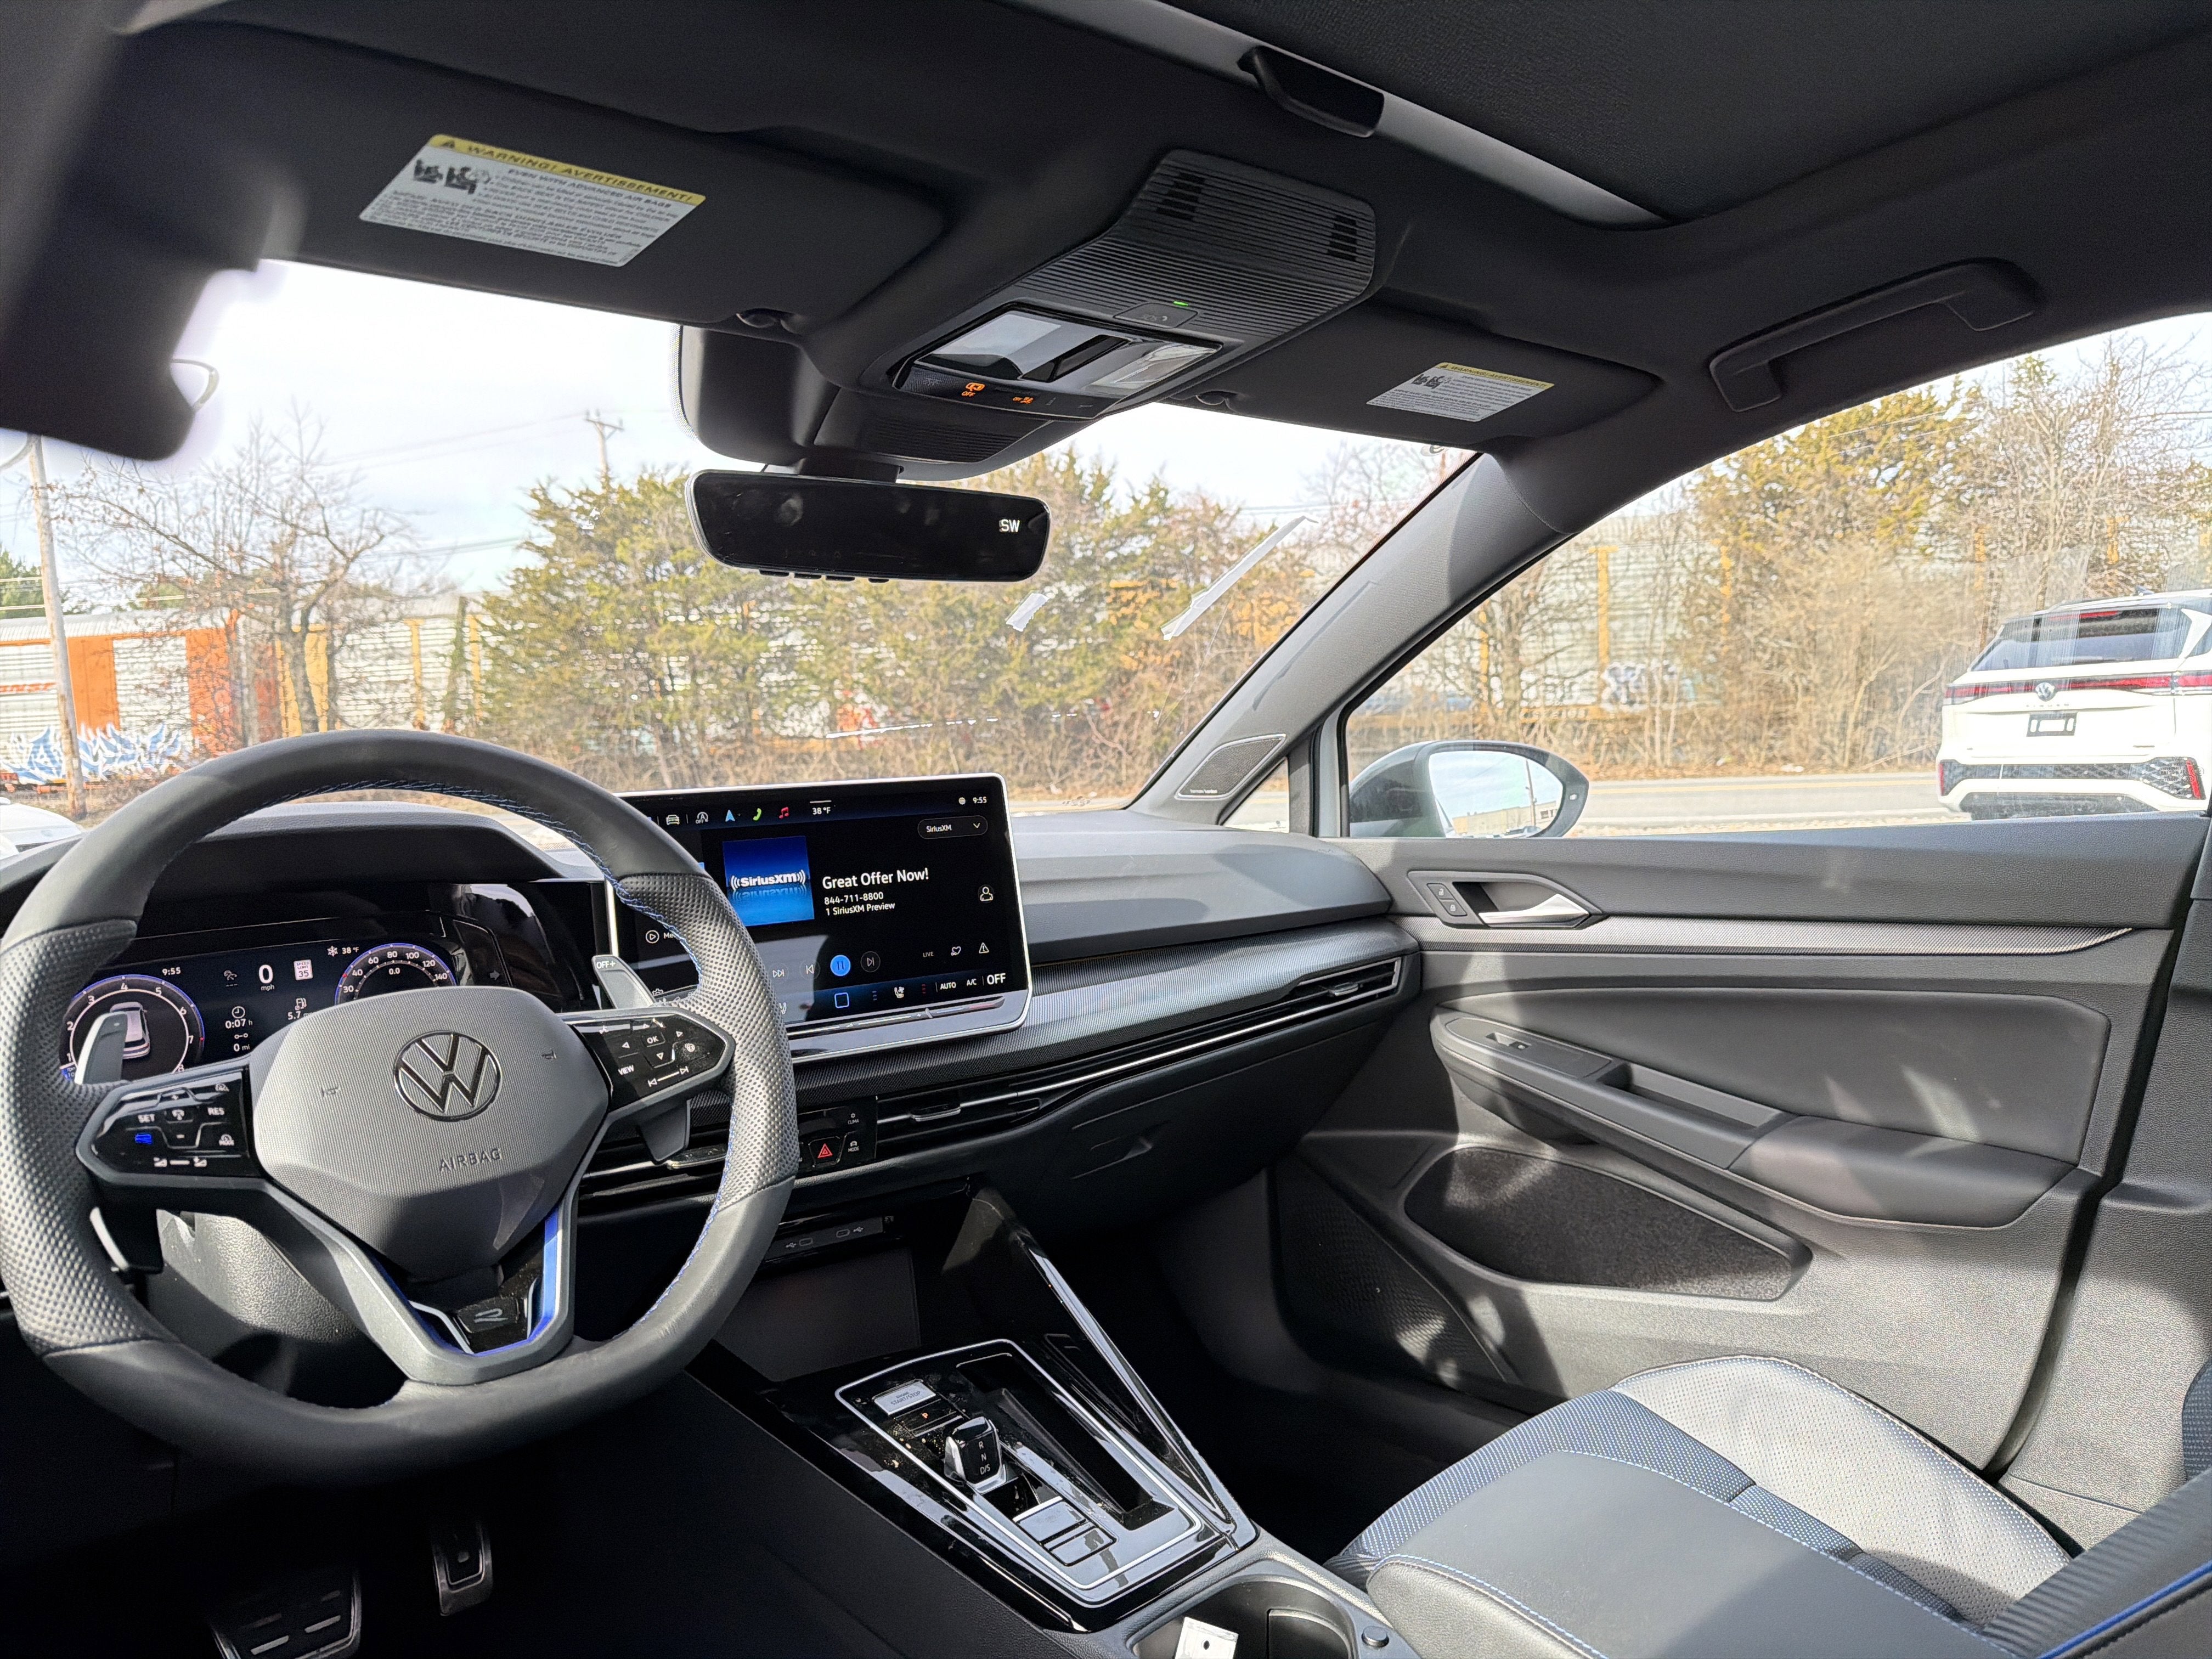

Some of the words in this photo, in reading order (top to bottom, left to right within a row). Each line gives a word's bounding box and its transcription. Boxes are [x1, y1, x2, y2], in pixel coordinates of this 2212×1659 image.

[1001, 518, 1020, 533] SW
[812, 807, 822, 815] 38
[926, 824, 952, 833] SiriusXM
[822, 875, 858, 889] Great
[860, 871, 894, 885] Offer
[896, 867, 929, 882] Now!
[824, 891, 884, 905] 844-711-8800
[832, 904, 865, 915] SiriusXM
[866, 902, 895, 912] Preview
[422, 960, 436, 968] 120
[162, 967, 181, 975] 9:55
[258, 964, 273, 984] 0
[940, 981, 957, 990] AUTO
[966, 978, 977, 986] A/C
[986, 973, 1006, 985] OFF
[155, 987, 162, 996] 5
[88, 995, 95, 1005] 3
[180, 1006, 187, 1015] 6
[287, 1011, 301, 1020] 5.7
[66, 1021, 74, 1031] 2
[225, 1018, 246, 1029] 0:07
[189, 1035, 194, 1043] 7
[646, 1035, 659, 1044] OK
[233, 1043, 240, 1052] 0
[67, 1053, 71, 1062] 1
[618, 1064, 634, 1075] VIEW
[207, 1107, 225, 1115] RES
[138, 1114, 155, 1123] SET
[439, 1148, 503, 1172] AIRBAG
[890, 1391, 921, 1406] START/STOP
[978, 1441, 984, 1450] R
[981, 1452, 987, 1462] N
[980, 1463, 991, 1475] D/S
